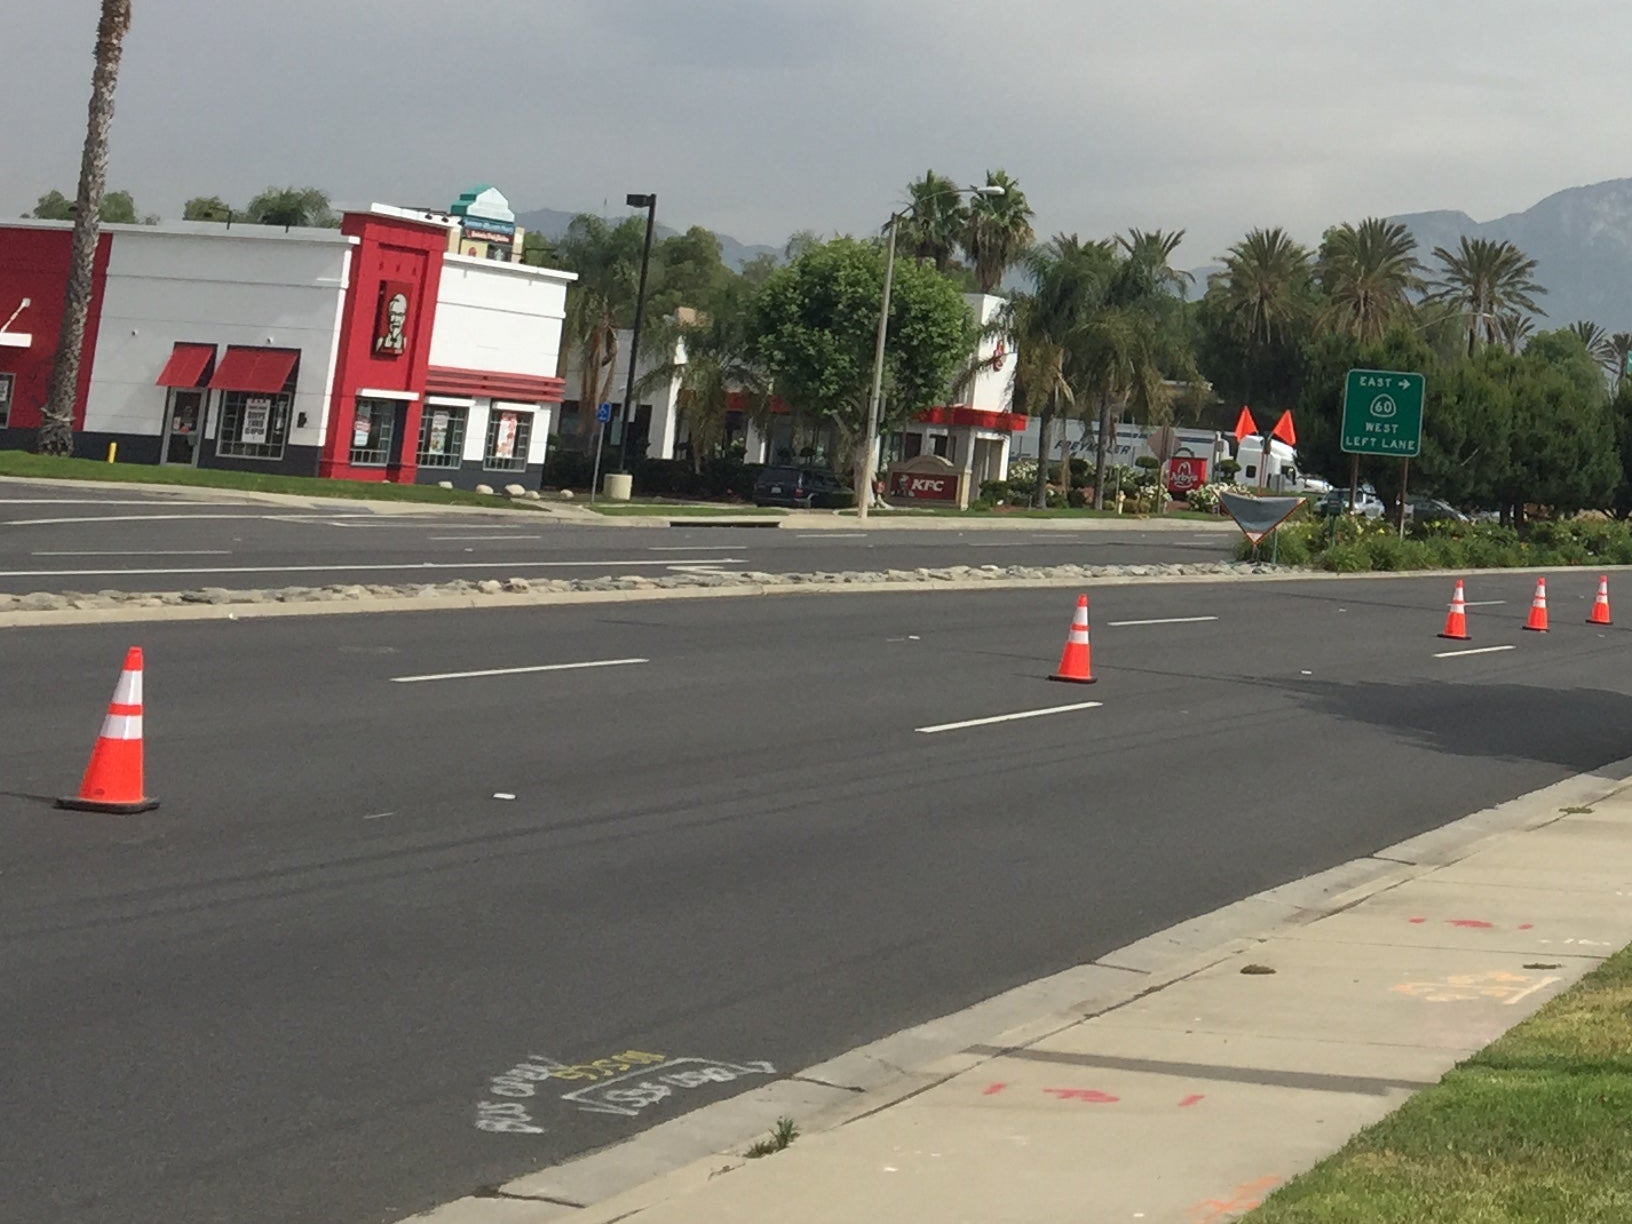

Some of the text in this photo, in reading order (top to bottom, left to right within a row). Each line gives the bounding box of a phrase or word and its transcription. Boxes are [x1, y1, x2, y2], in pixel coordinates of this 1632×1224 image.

[1359, 375, 1392, 387] EAST
[1374, 400, 1392, 414] 60
[1365, 422, 1399, 434] WEST
[1345, 436, 1416, 451] LEFT LANE
[910, 478, 945, 492] KFC
